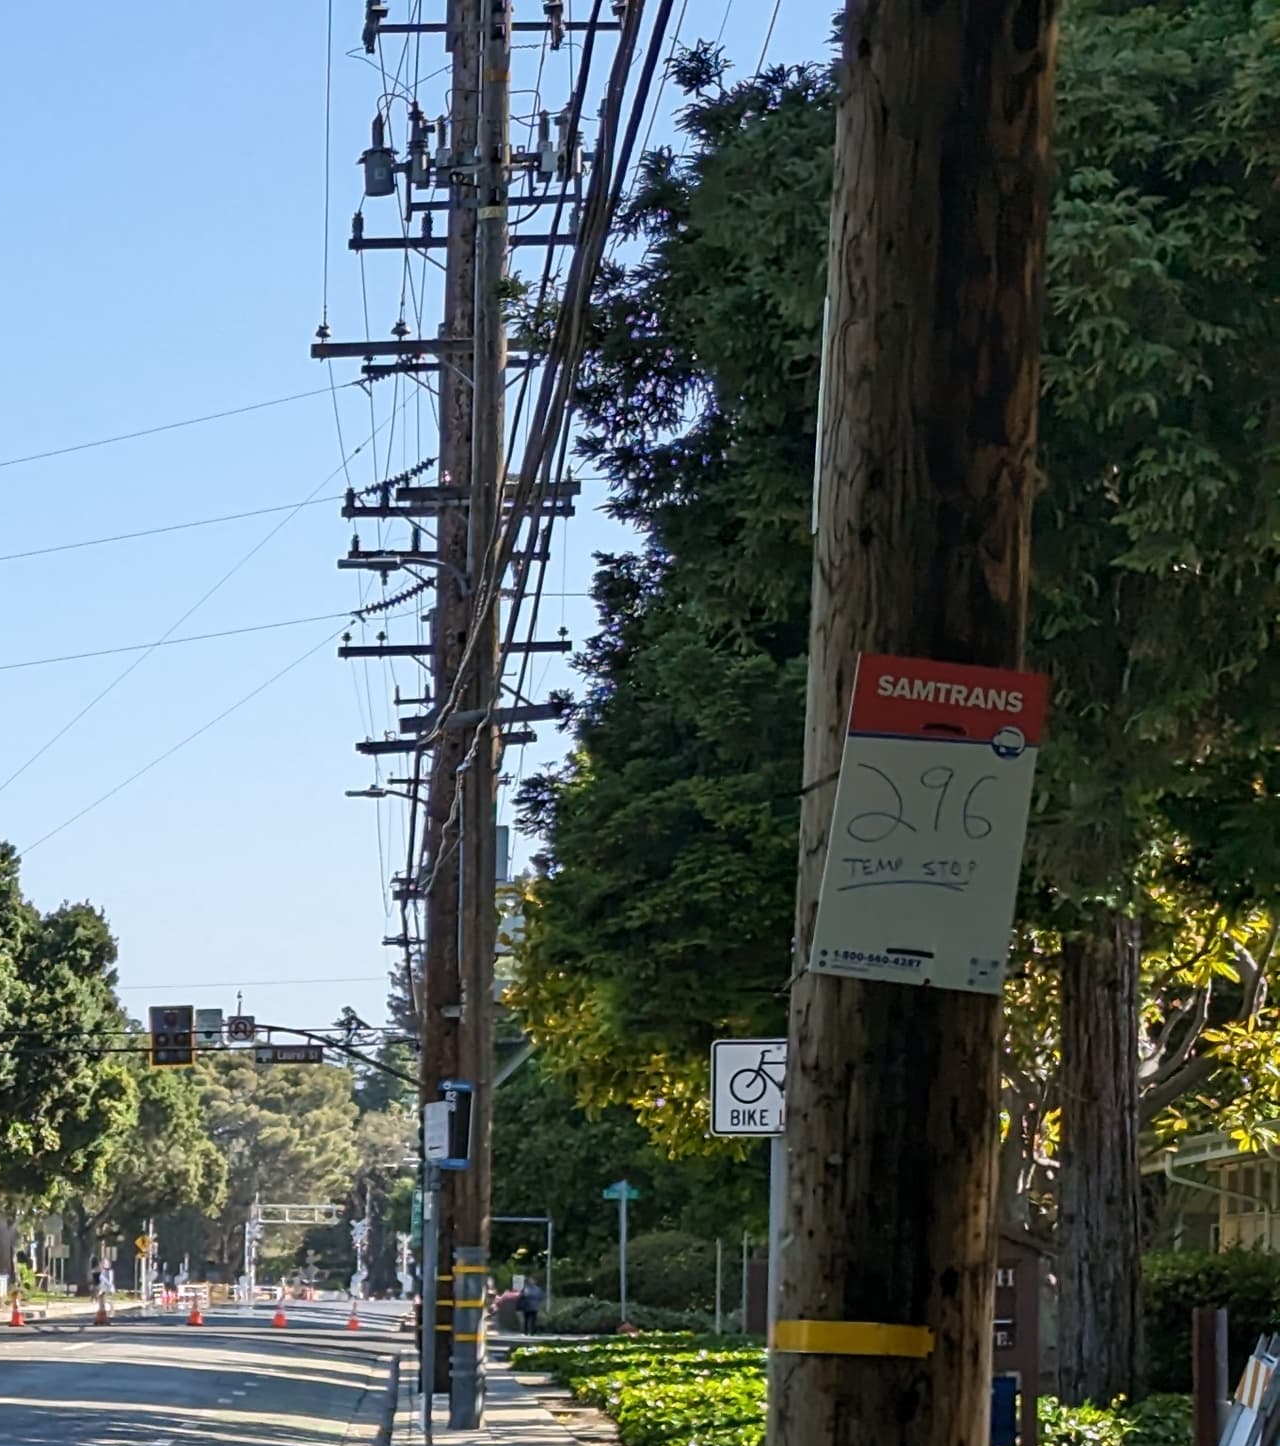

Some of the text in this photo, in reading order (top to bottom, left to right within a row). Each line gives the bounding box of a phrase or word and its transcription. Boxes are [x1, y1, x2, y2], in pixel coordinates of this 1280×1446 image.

[877, 674, 1024, 714] SAMTRANS
[847, 763, 997, 842] 296
[842, 857, 977, 878] TEMP STOP
[730, 1108, 770, 1127] BIKE
